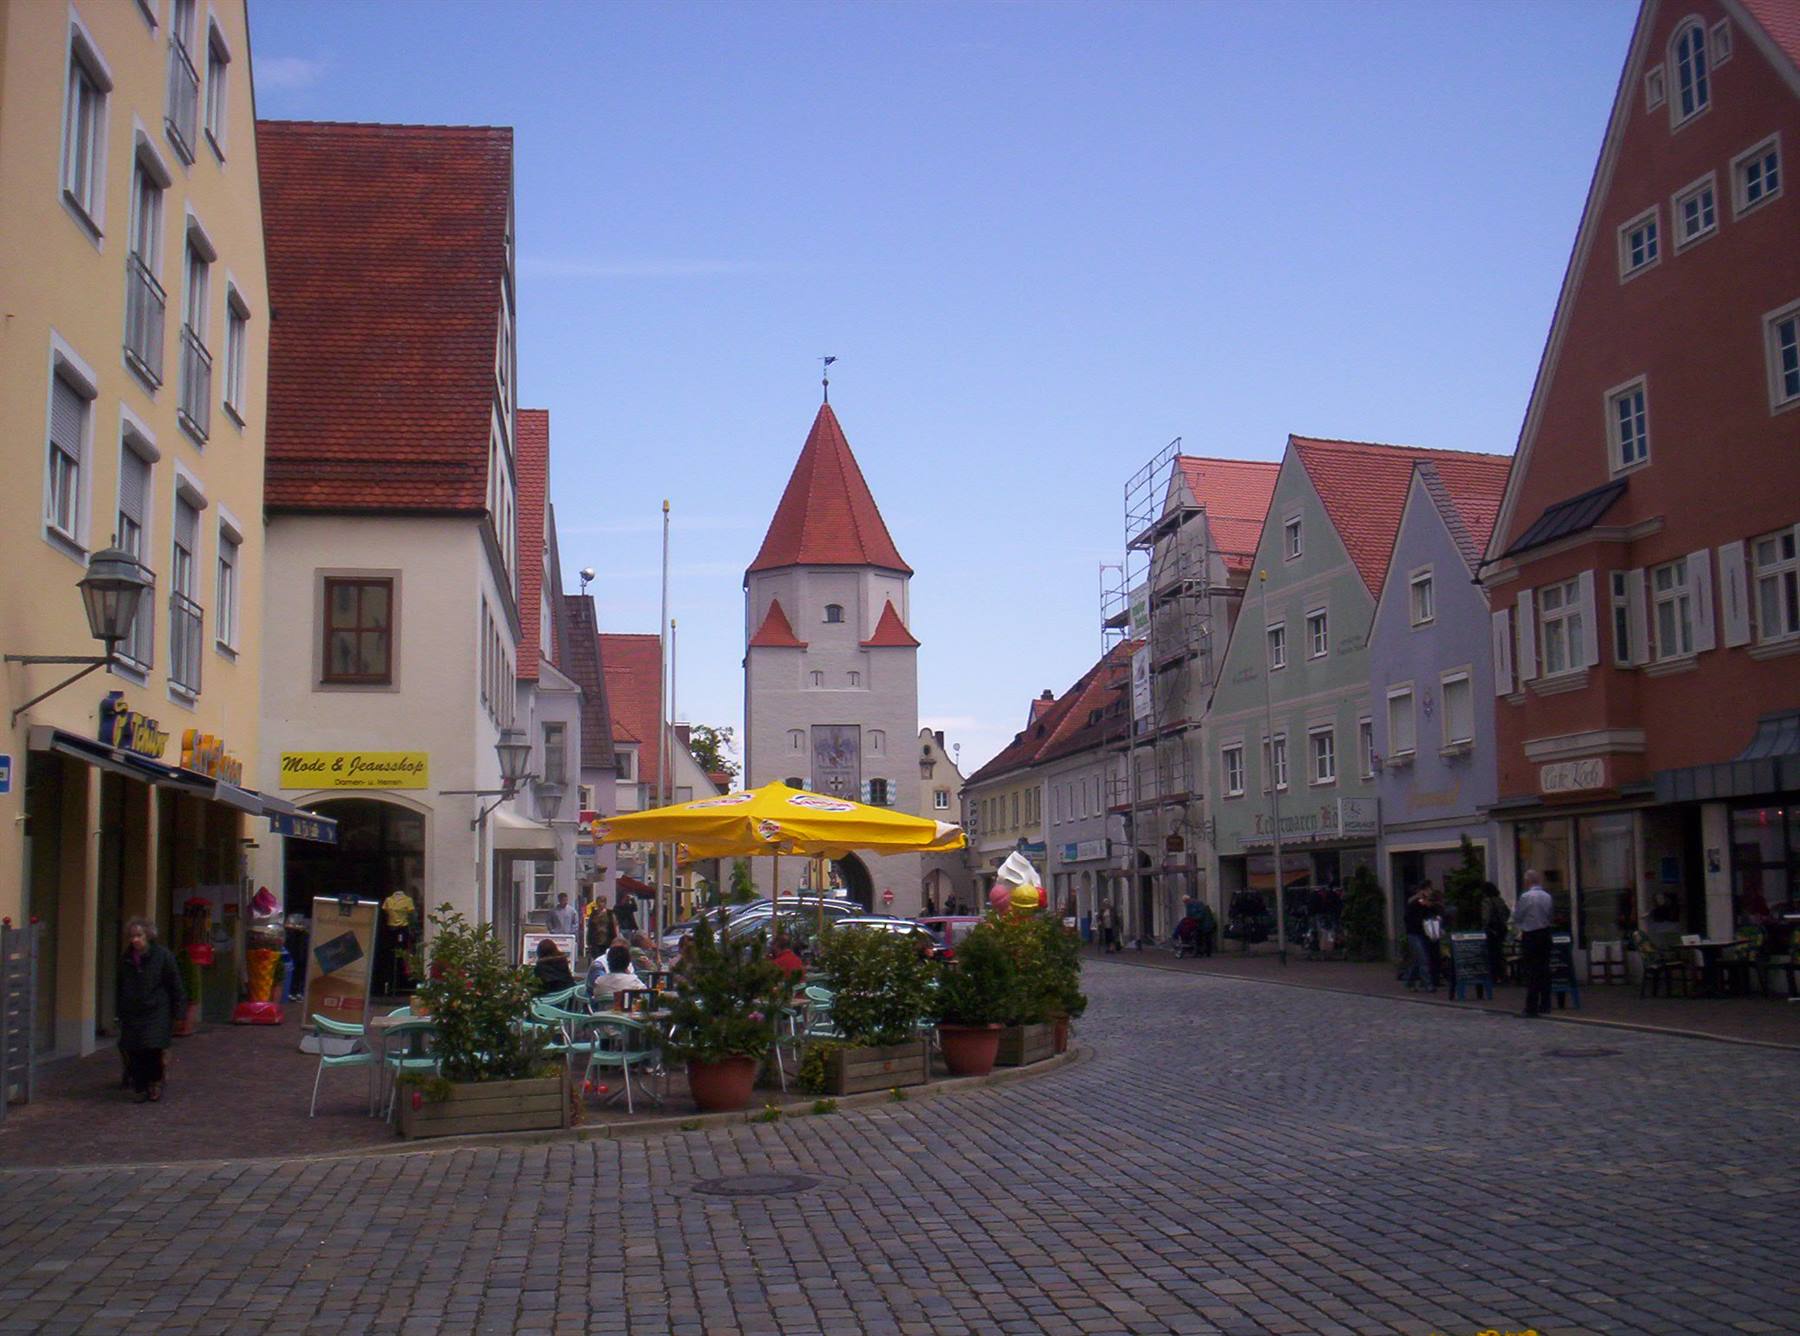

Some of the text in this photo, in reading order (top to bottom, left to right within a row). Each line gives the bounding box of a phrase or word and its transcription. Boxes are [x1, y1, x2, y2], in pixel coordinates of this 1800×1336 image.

[282, 756, 424, 777] Mode & Jeansshop
[969, 800, 977, 845] SPORT
